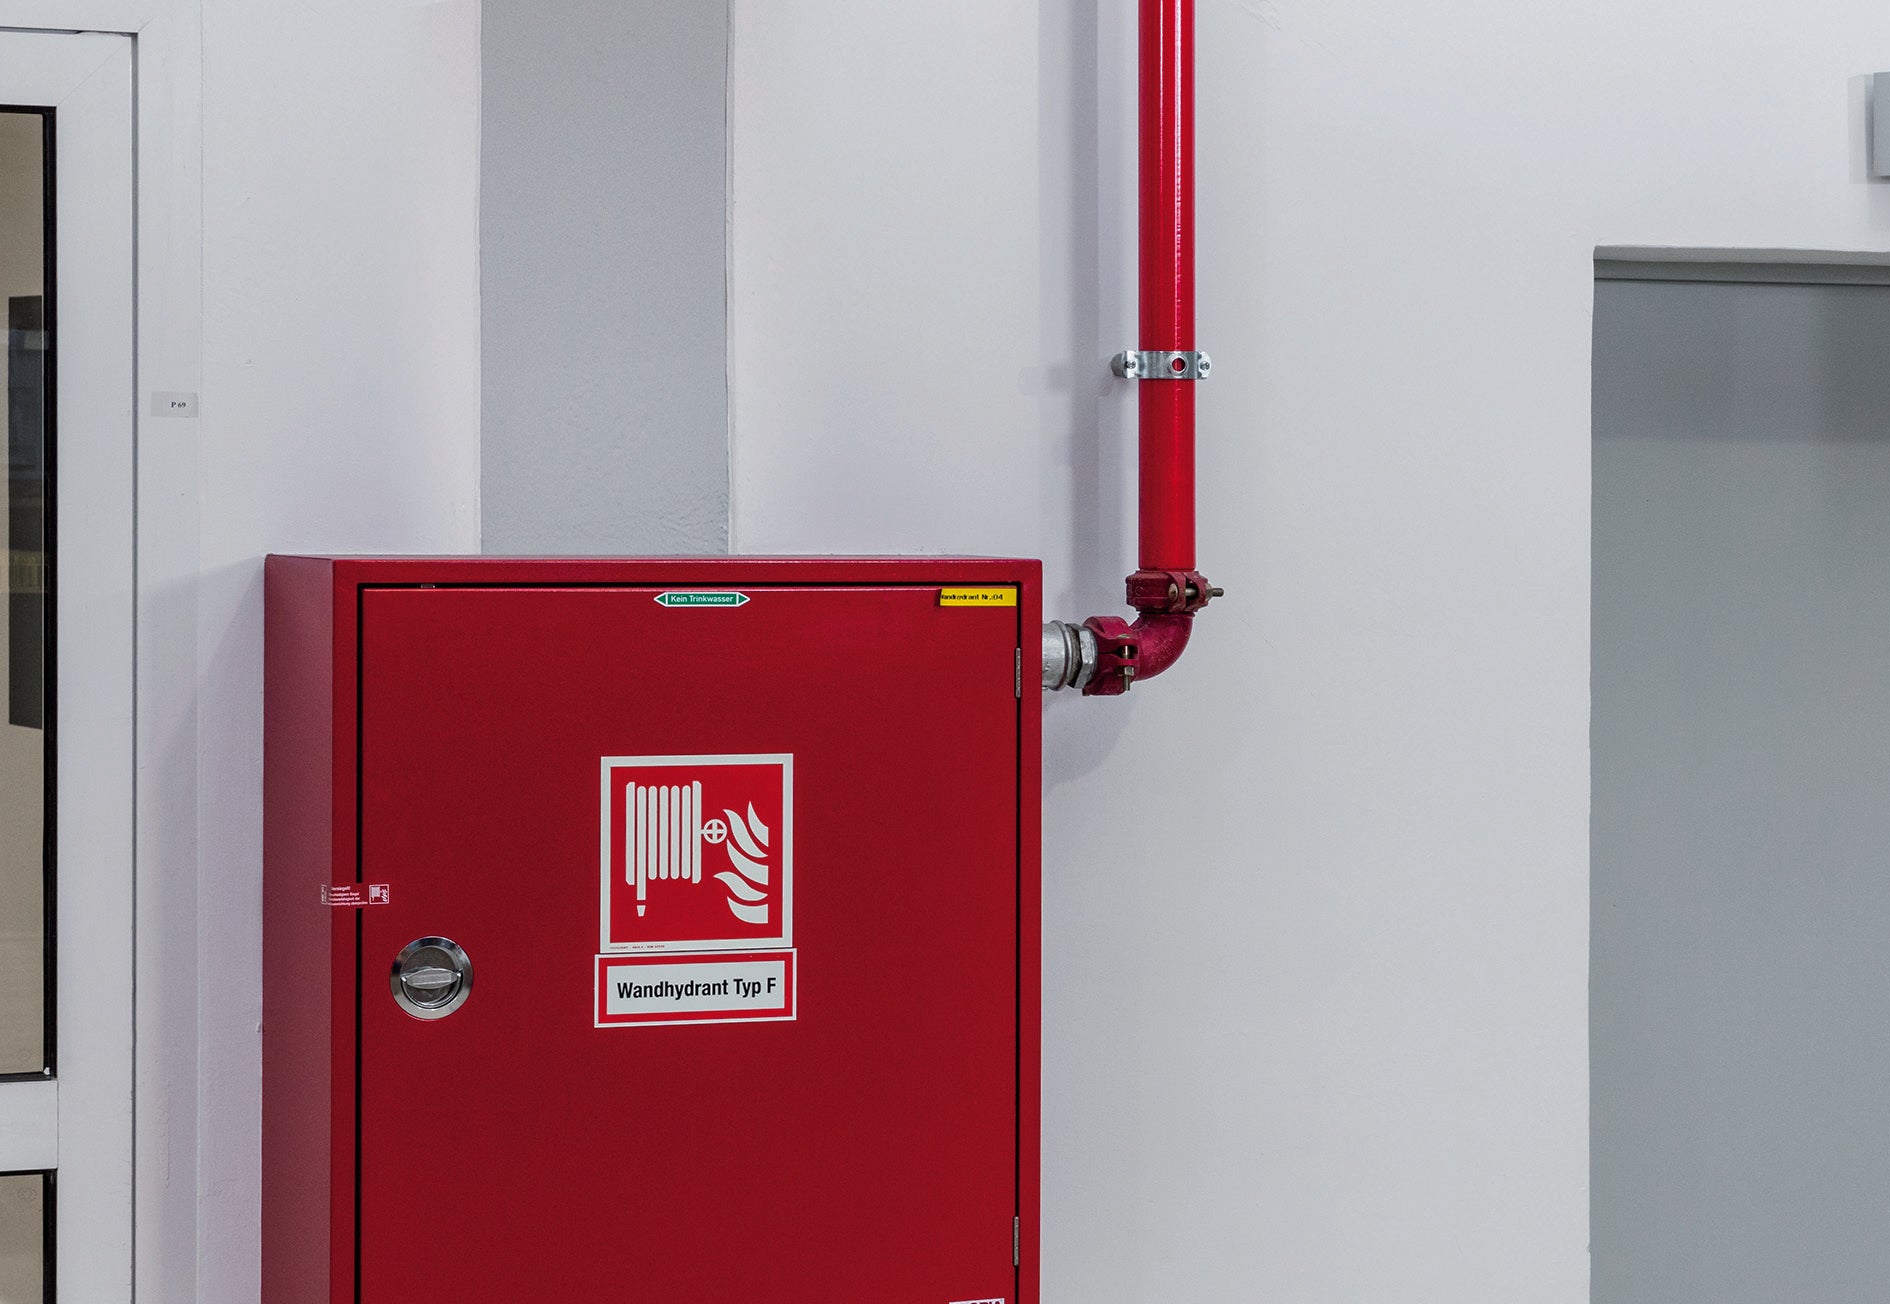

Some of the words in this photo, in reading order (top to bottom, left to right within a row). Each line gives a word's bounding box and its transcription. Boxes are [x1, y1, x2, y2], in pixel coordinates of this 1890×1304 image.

[617, 980, 728, 1000] Wandhydrant
[733, 978, 762, 998] Typ
[767, 977, 777, 994] F
